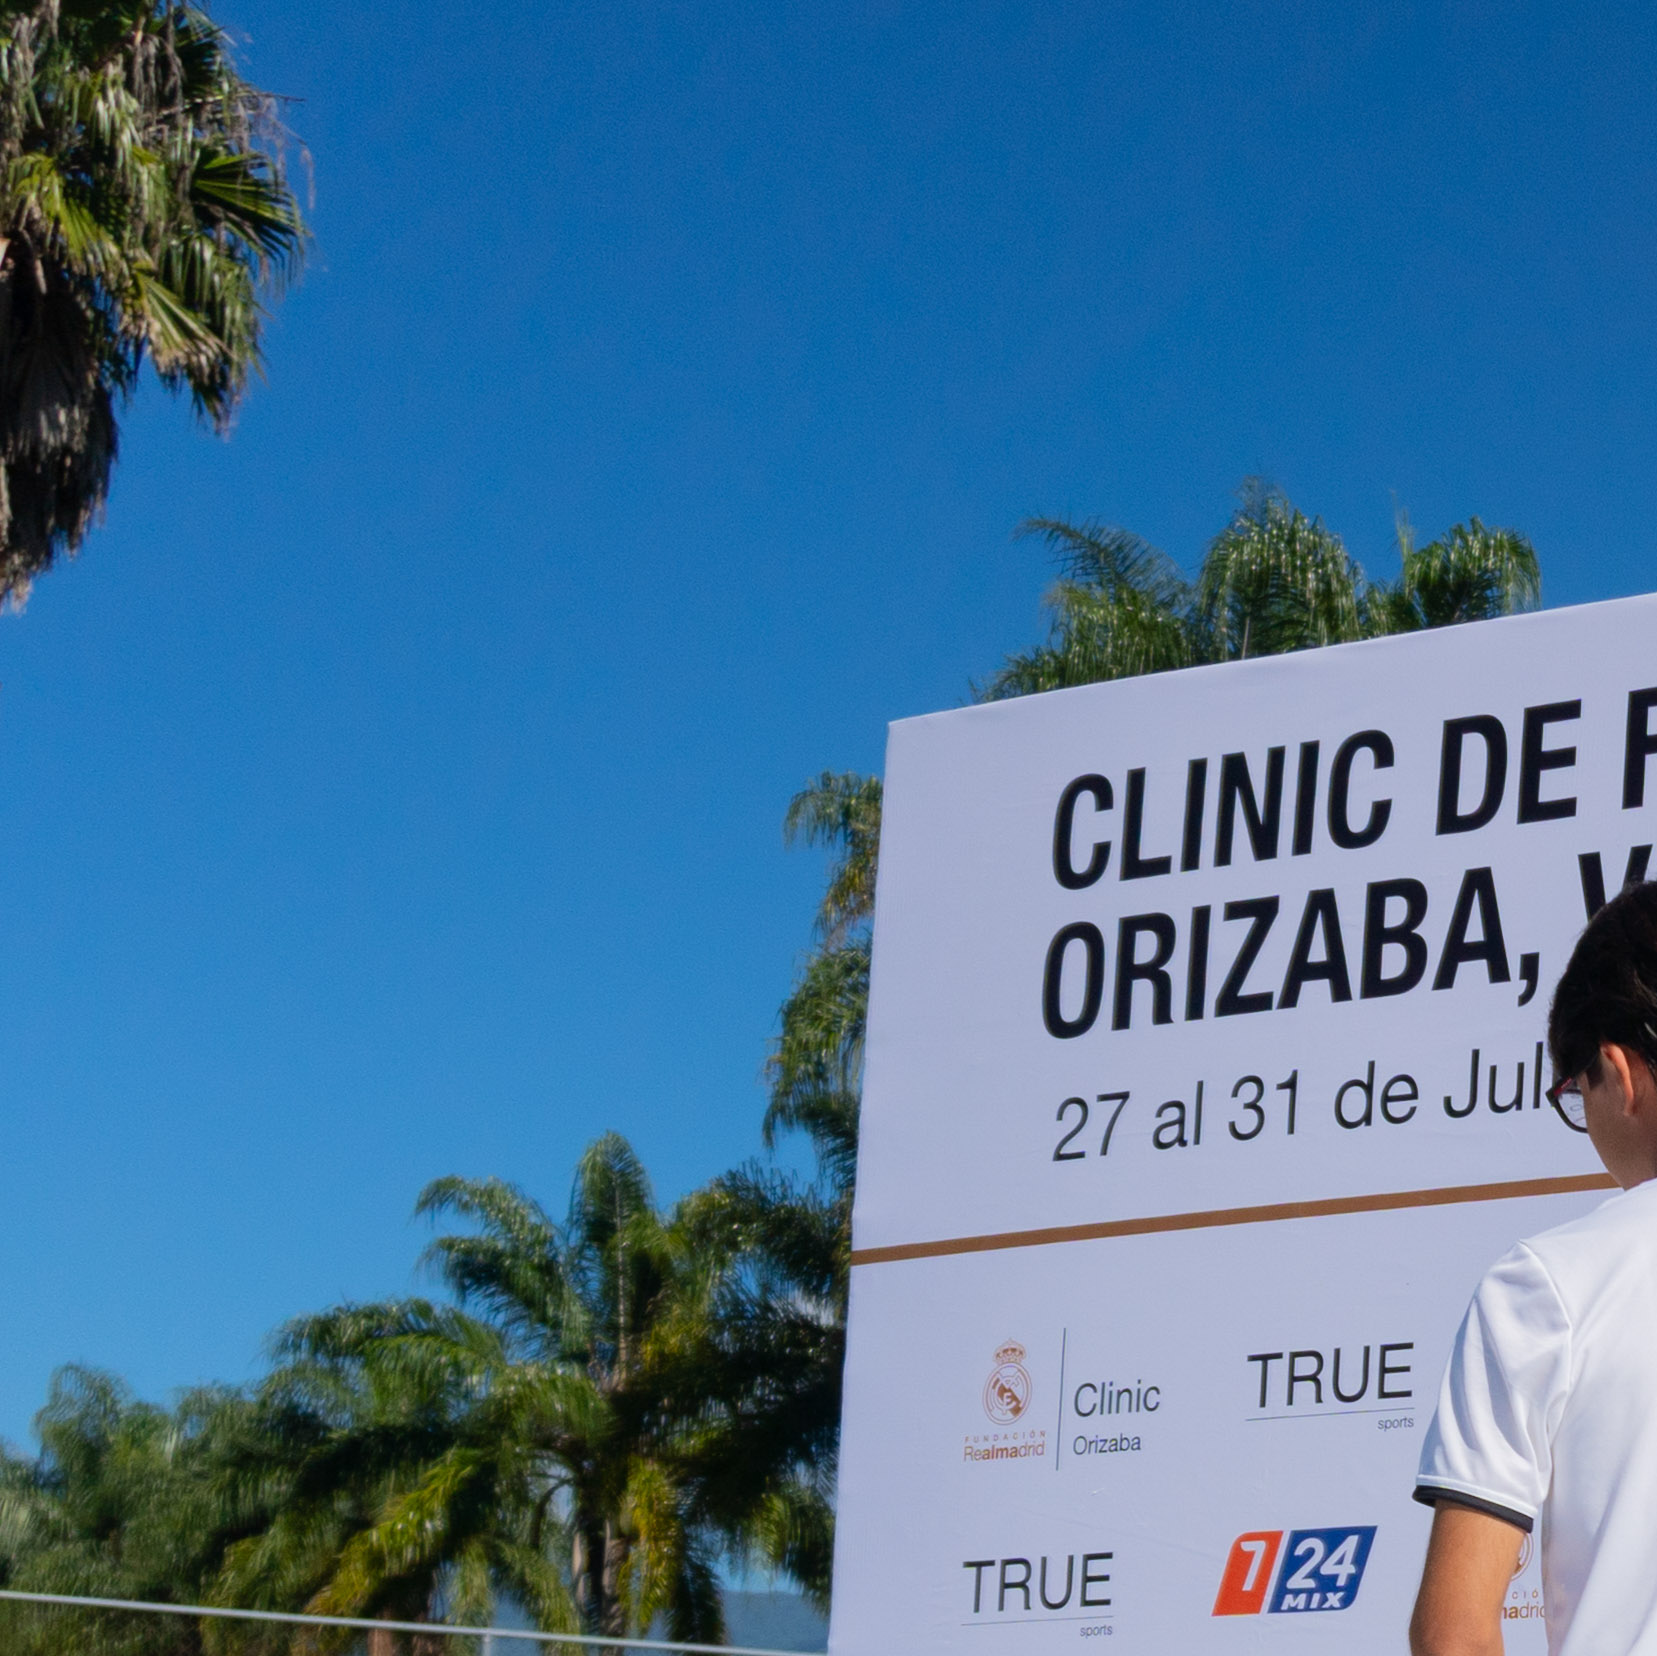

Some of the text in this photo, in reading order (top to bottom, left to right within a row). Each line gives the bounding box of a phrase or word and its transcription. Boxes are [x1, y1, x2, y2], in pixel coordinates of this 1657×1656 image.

[1052, 730, 1394, 889] CLINIC
[1436, 699, 1581, 835] DE
[1042, 866, 1540, 1039] ORIZABA,
[1053, 1041, 1545, 1161] 27 al 31 de Jul
[1248, 1342, 1414, 1408] TRUE
[1074, 1379, 1160, 1417] Clinic
[1073, 1433, 1141, 1455] Orizaba
[1378, 1416, 1414, 1432] sports
[963, 1442, 1045, 1461] Realmadrid
[963, 1552, 1113, 1613] TRUE
[1286, 1535, 1358, 1588] 24
[1280, 1592, 1344, 1610] MIX
[1080, 1625, 1113, 1639] sports
